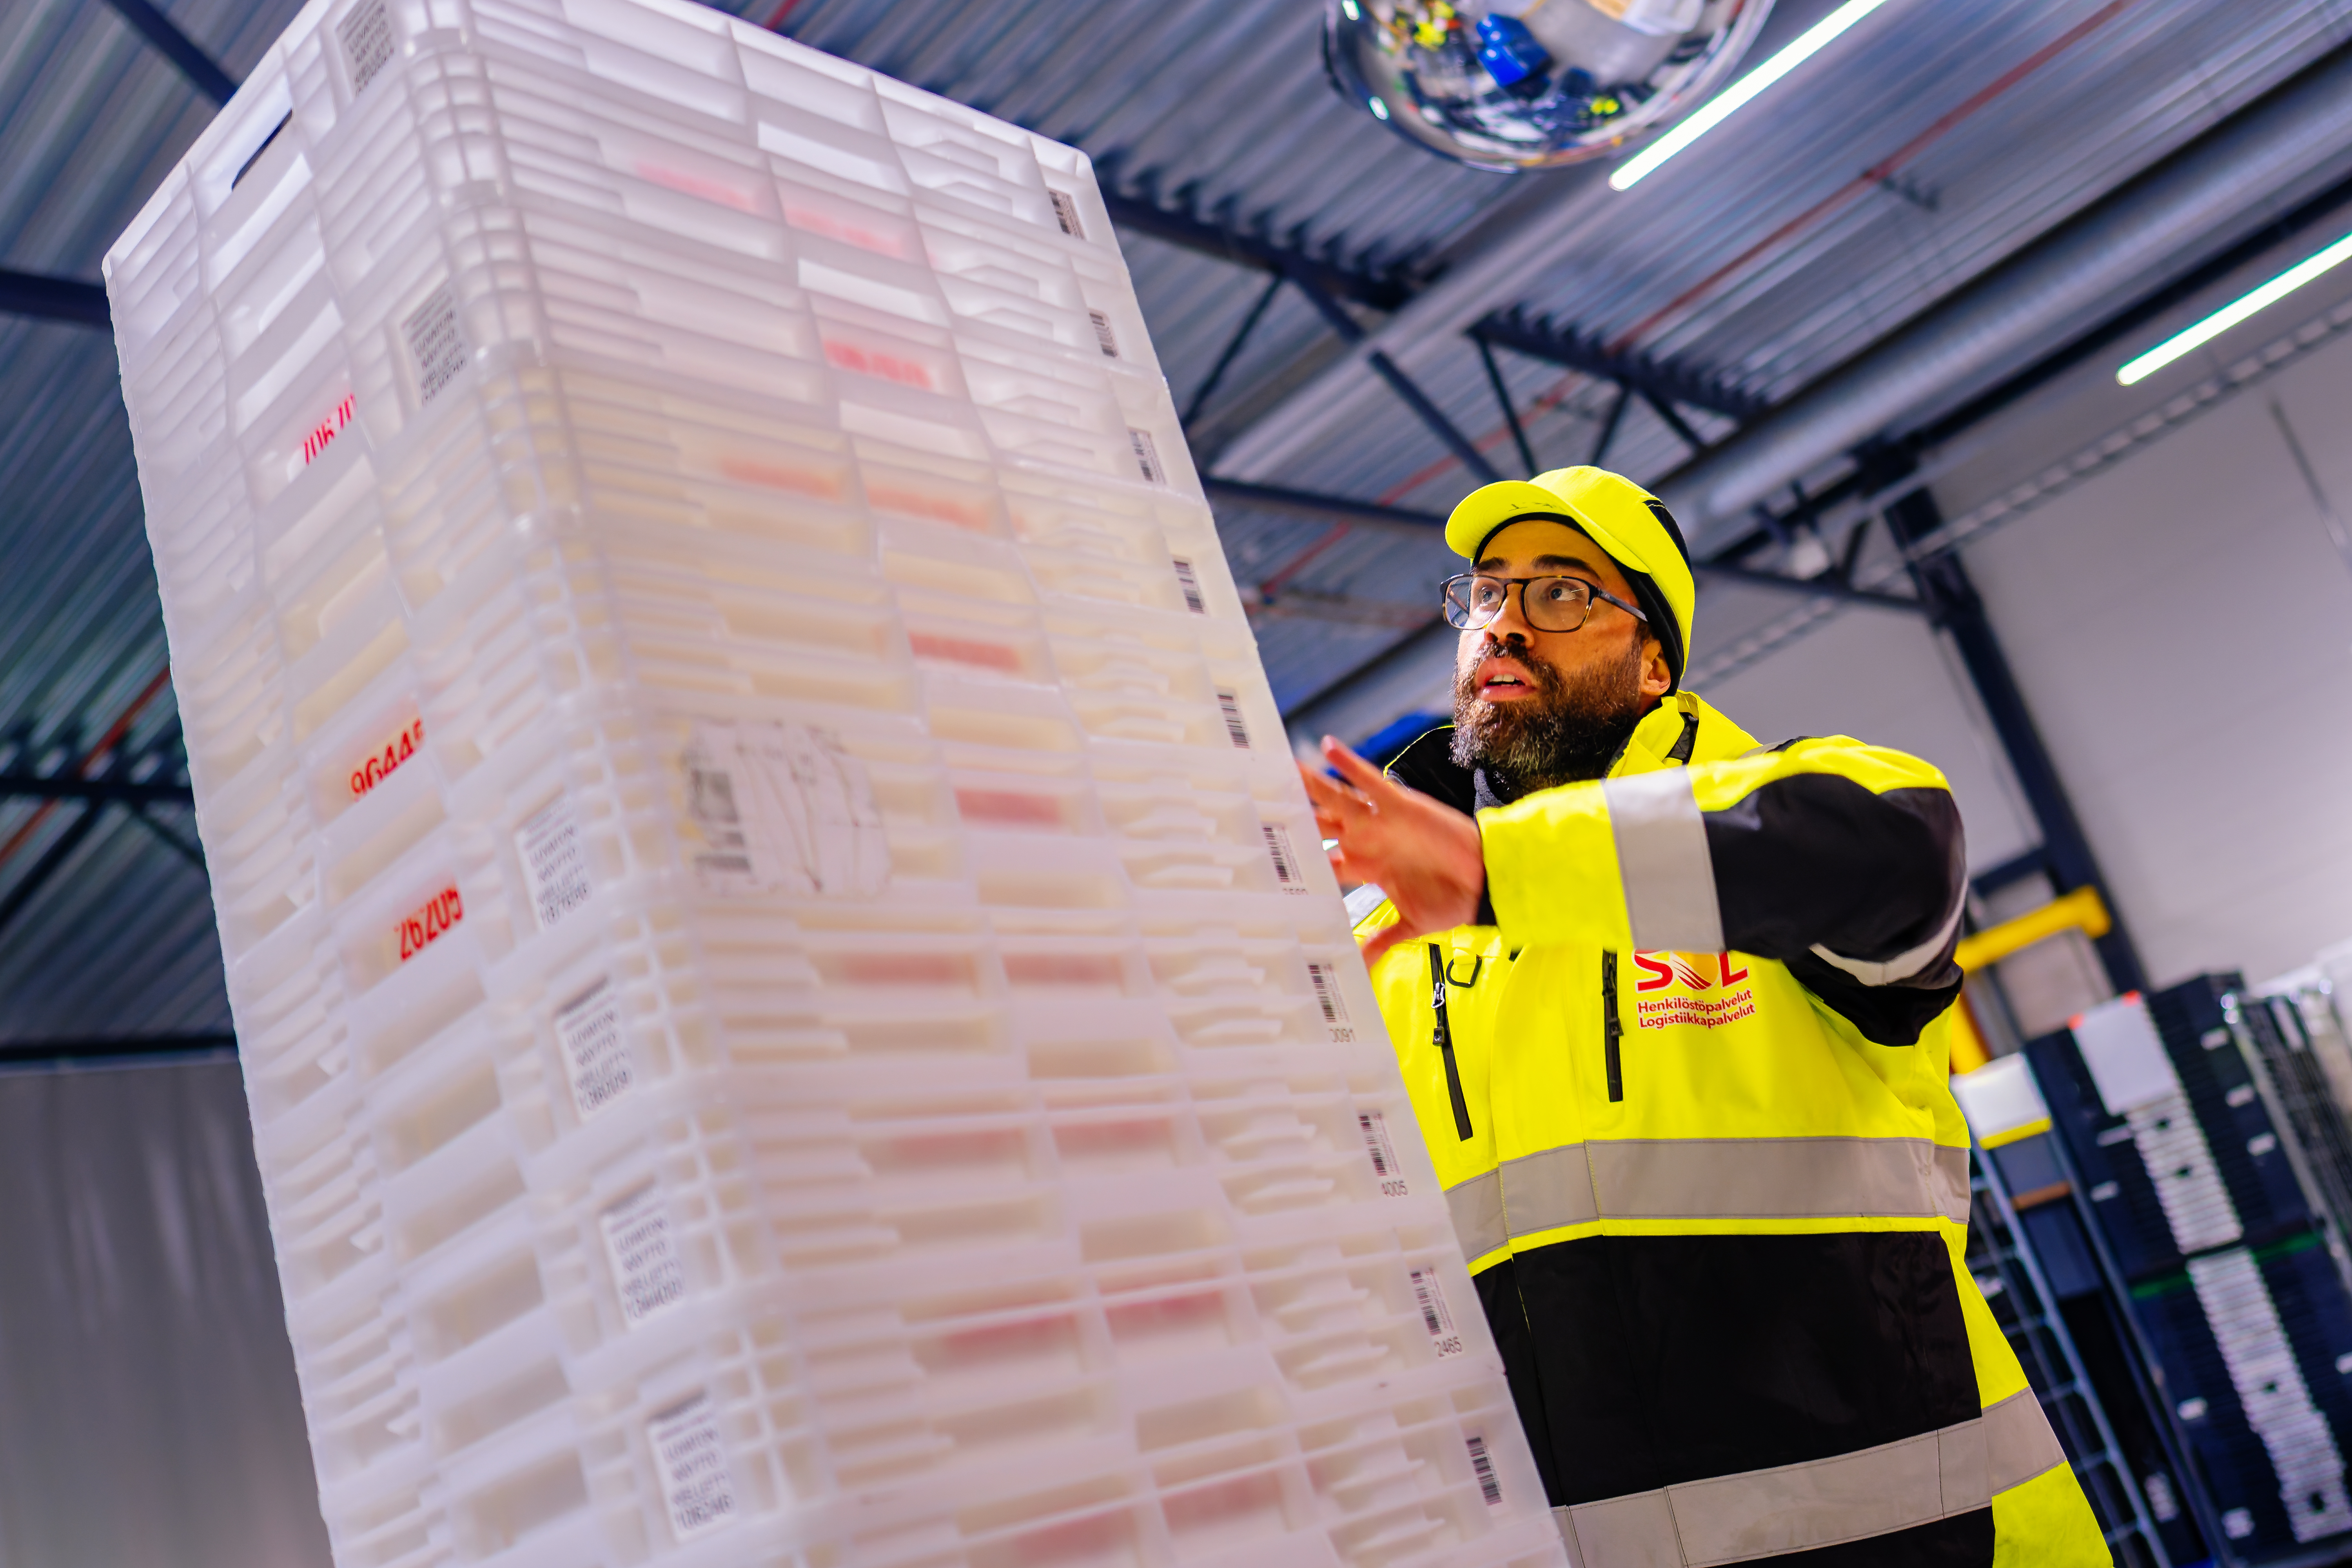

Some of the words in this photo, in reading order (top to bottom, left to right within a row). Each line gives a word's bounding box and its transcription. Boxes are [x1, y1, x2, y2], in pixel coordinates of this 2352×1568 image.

[1638, 989, 1753, 1015] Henkilöstöpalvelut
[1639, 1004, 1755, 1029] Logistiikkapalvelut
[1434, 1336, 1463, 1357] 2465
